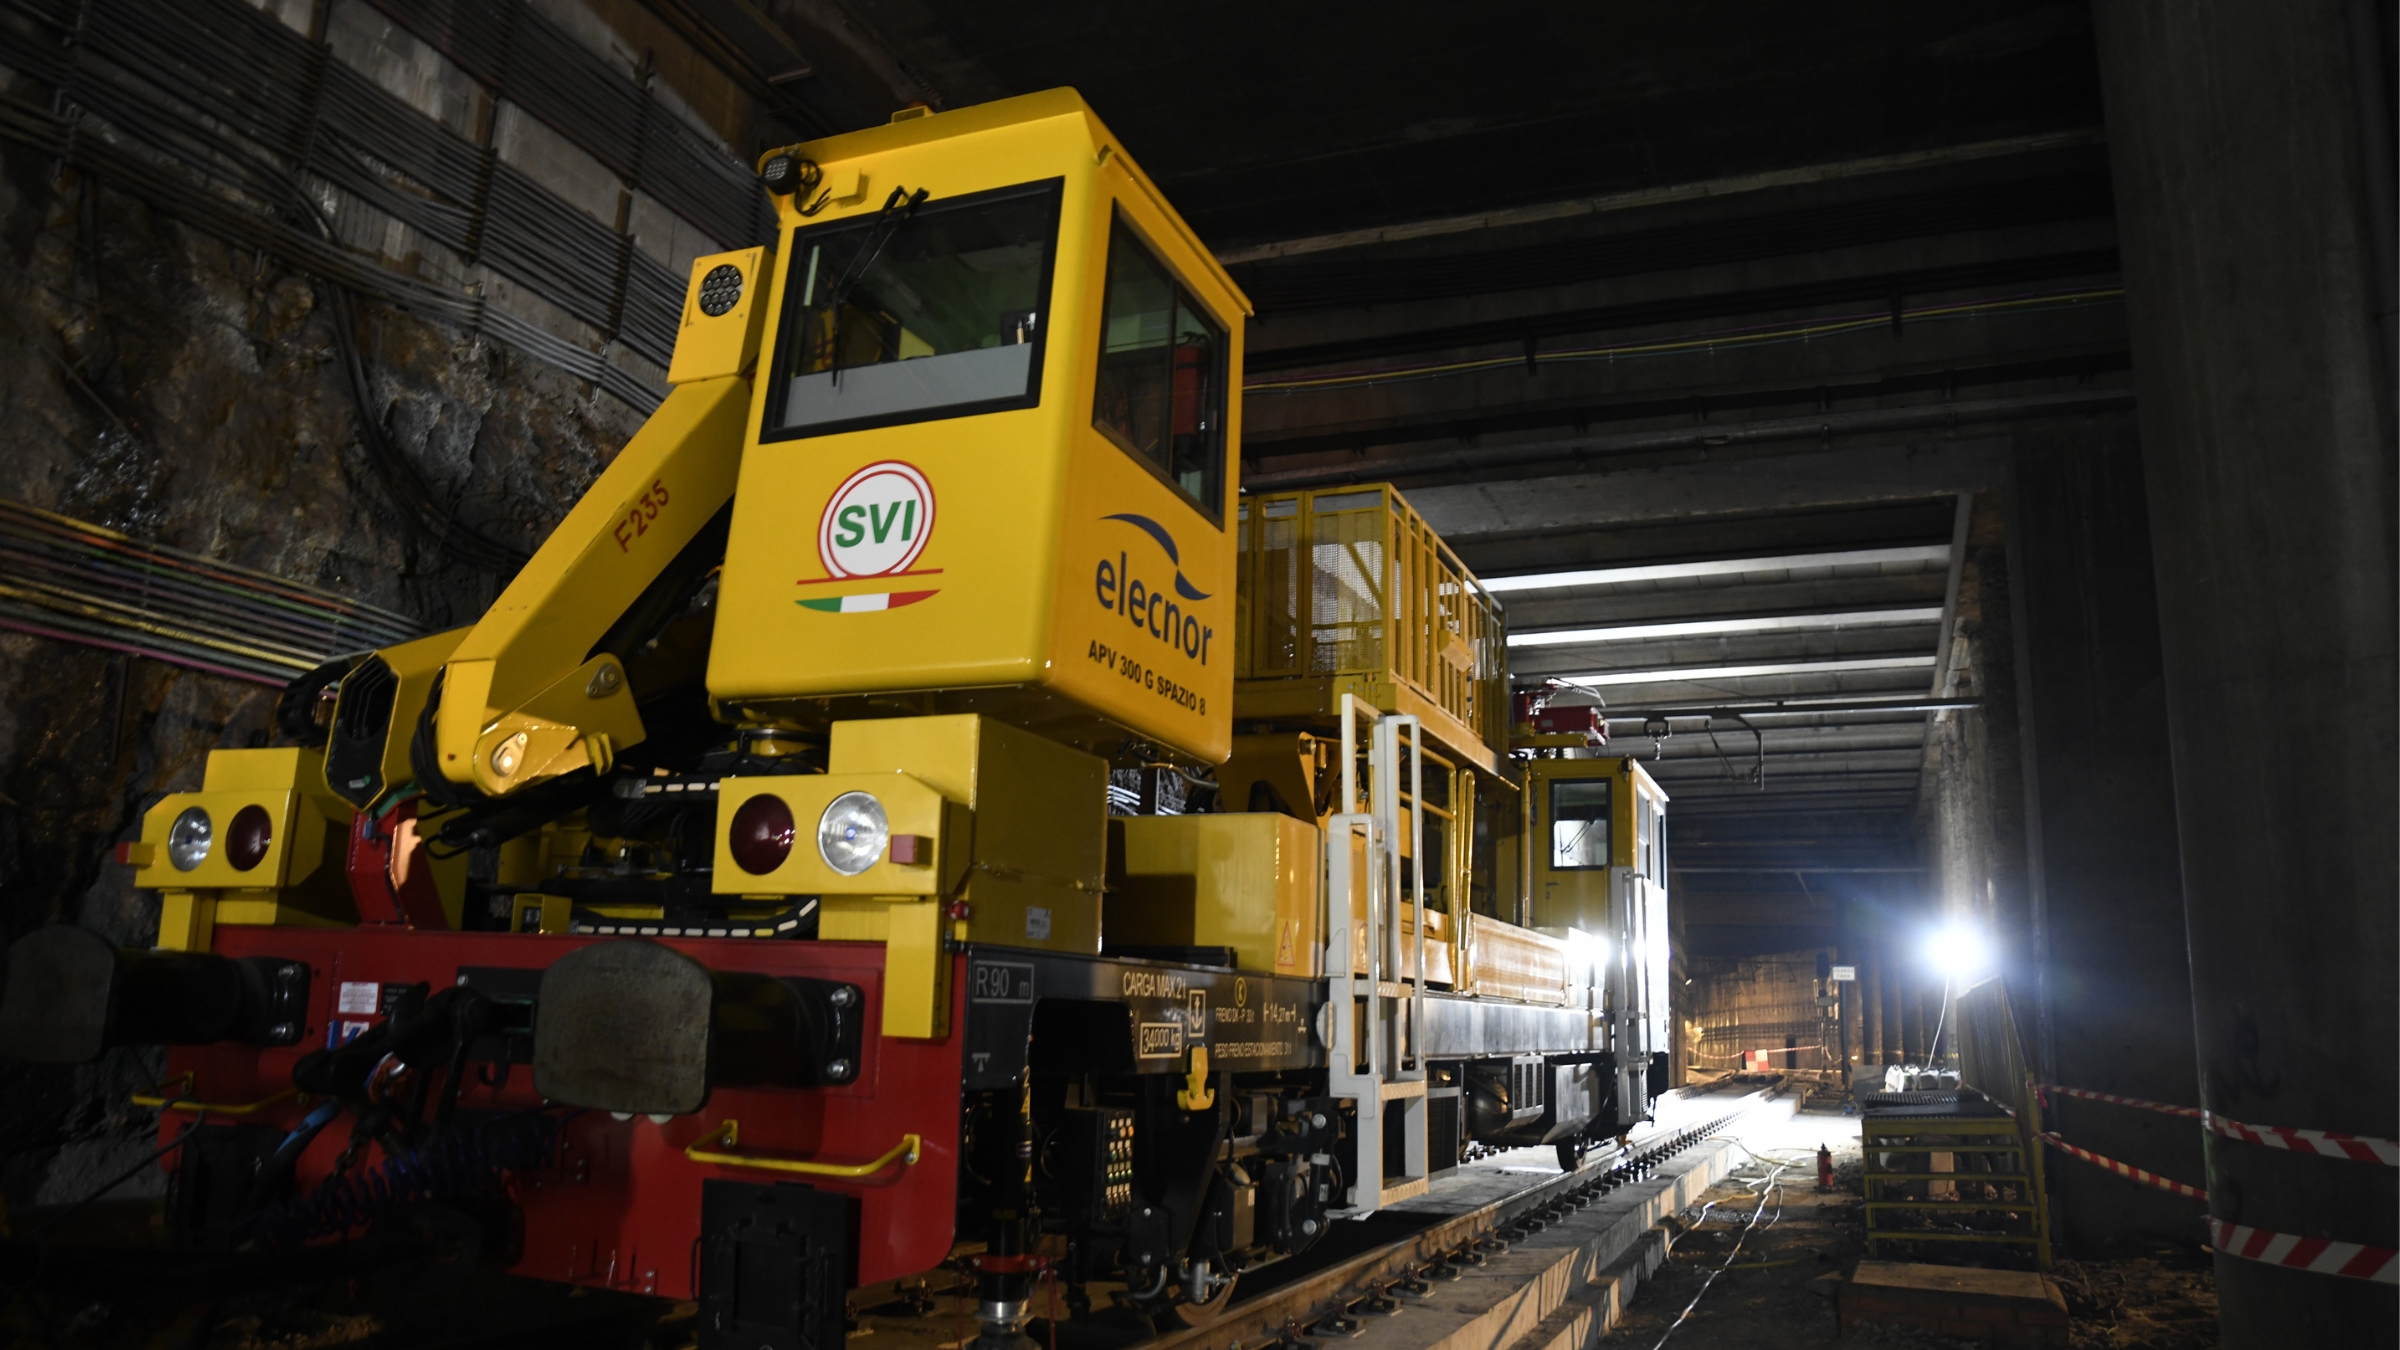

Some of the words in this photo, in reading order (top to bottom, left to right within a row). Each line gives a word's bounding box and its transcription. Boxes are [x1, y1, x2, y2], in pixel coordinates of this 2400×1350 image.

[614, 478, 669, 553] F235
[835, 499, 916, 548] SVI
[1096, 550, 1213, 666] elecnor
[1088, 639, 1117, 669] APV
[1120, 655, 1141, 683] 300
[1145, 669, 1154, 690] G
[1157, 675, 1197, 711] SPAZIO
[1199, 697, 1206, 716] 8
[1019, 981, 1030, 997] m
[1123, 971, 1156, 997] CARGA
[1156, 974, 1176, 998] MAX
[1143, 1028, 1170, 1053] 34000
[1171, 1027, 1180, 1051] kg
